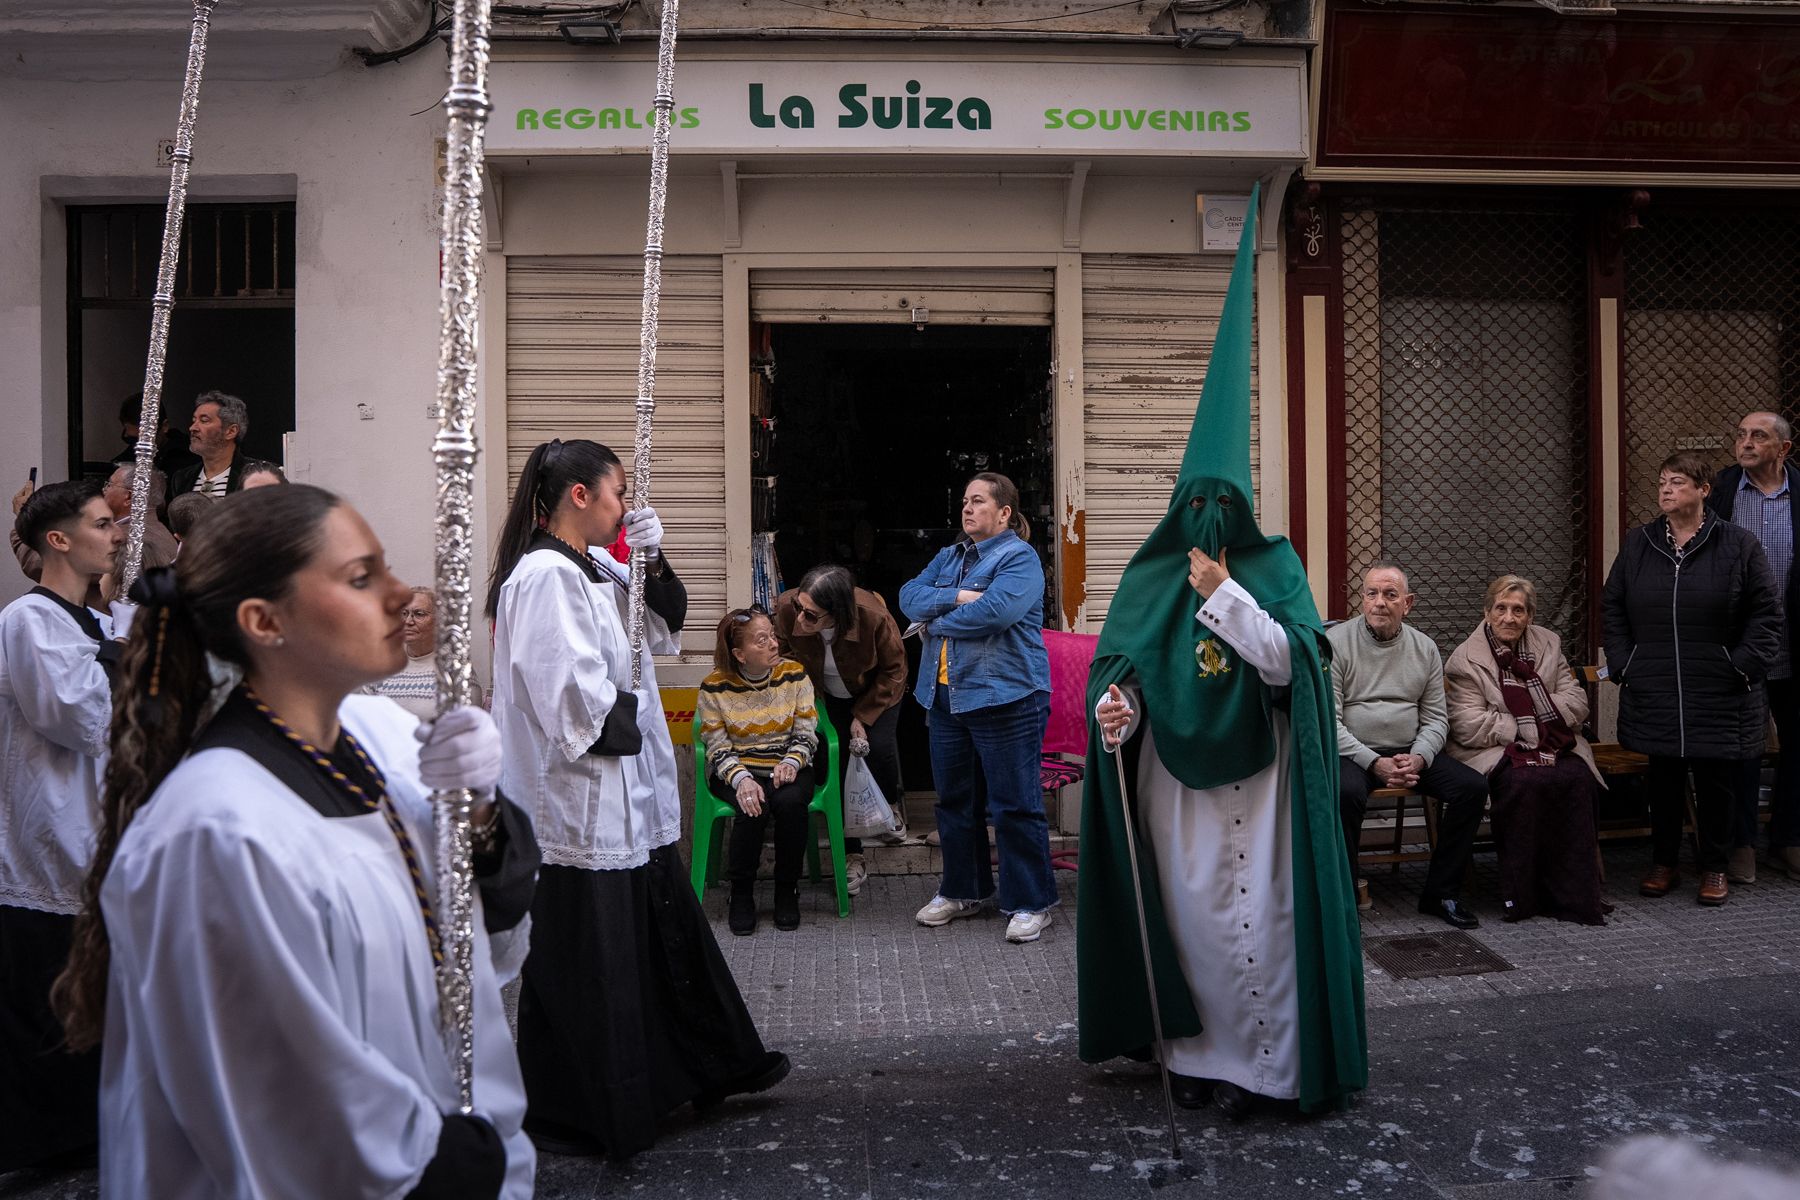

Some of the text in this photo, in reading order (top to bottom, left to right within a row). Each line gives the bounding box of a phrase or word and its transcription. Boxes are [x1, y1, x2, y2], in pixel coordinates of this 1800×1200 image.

[749, 79, 992, 131] La Suiza
[1044, 108, 1252, 132] SOUVENIRS
